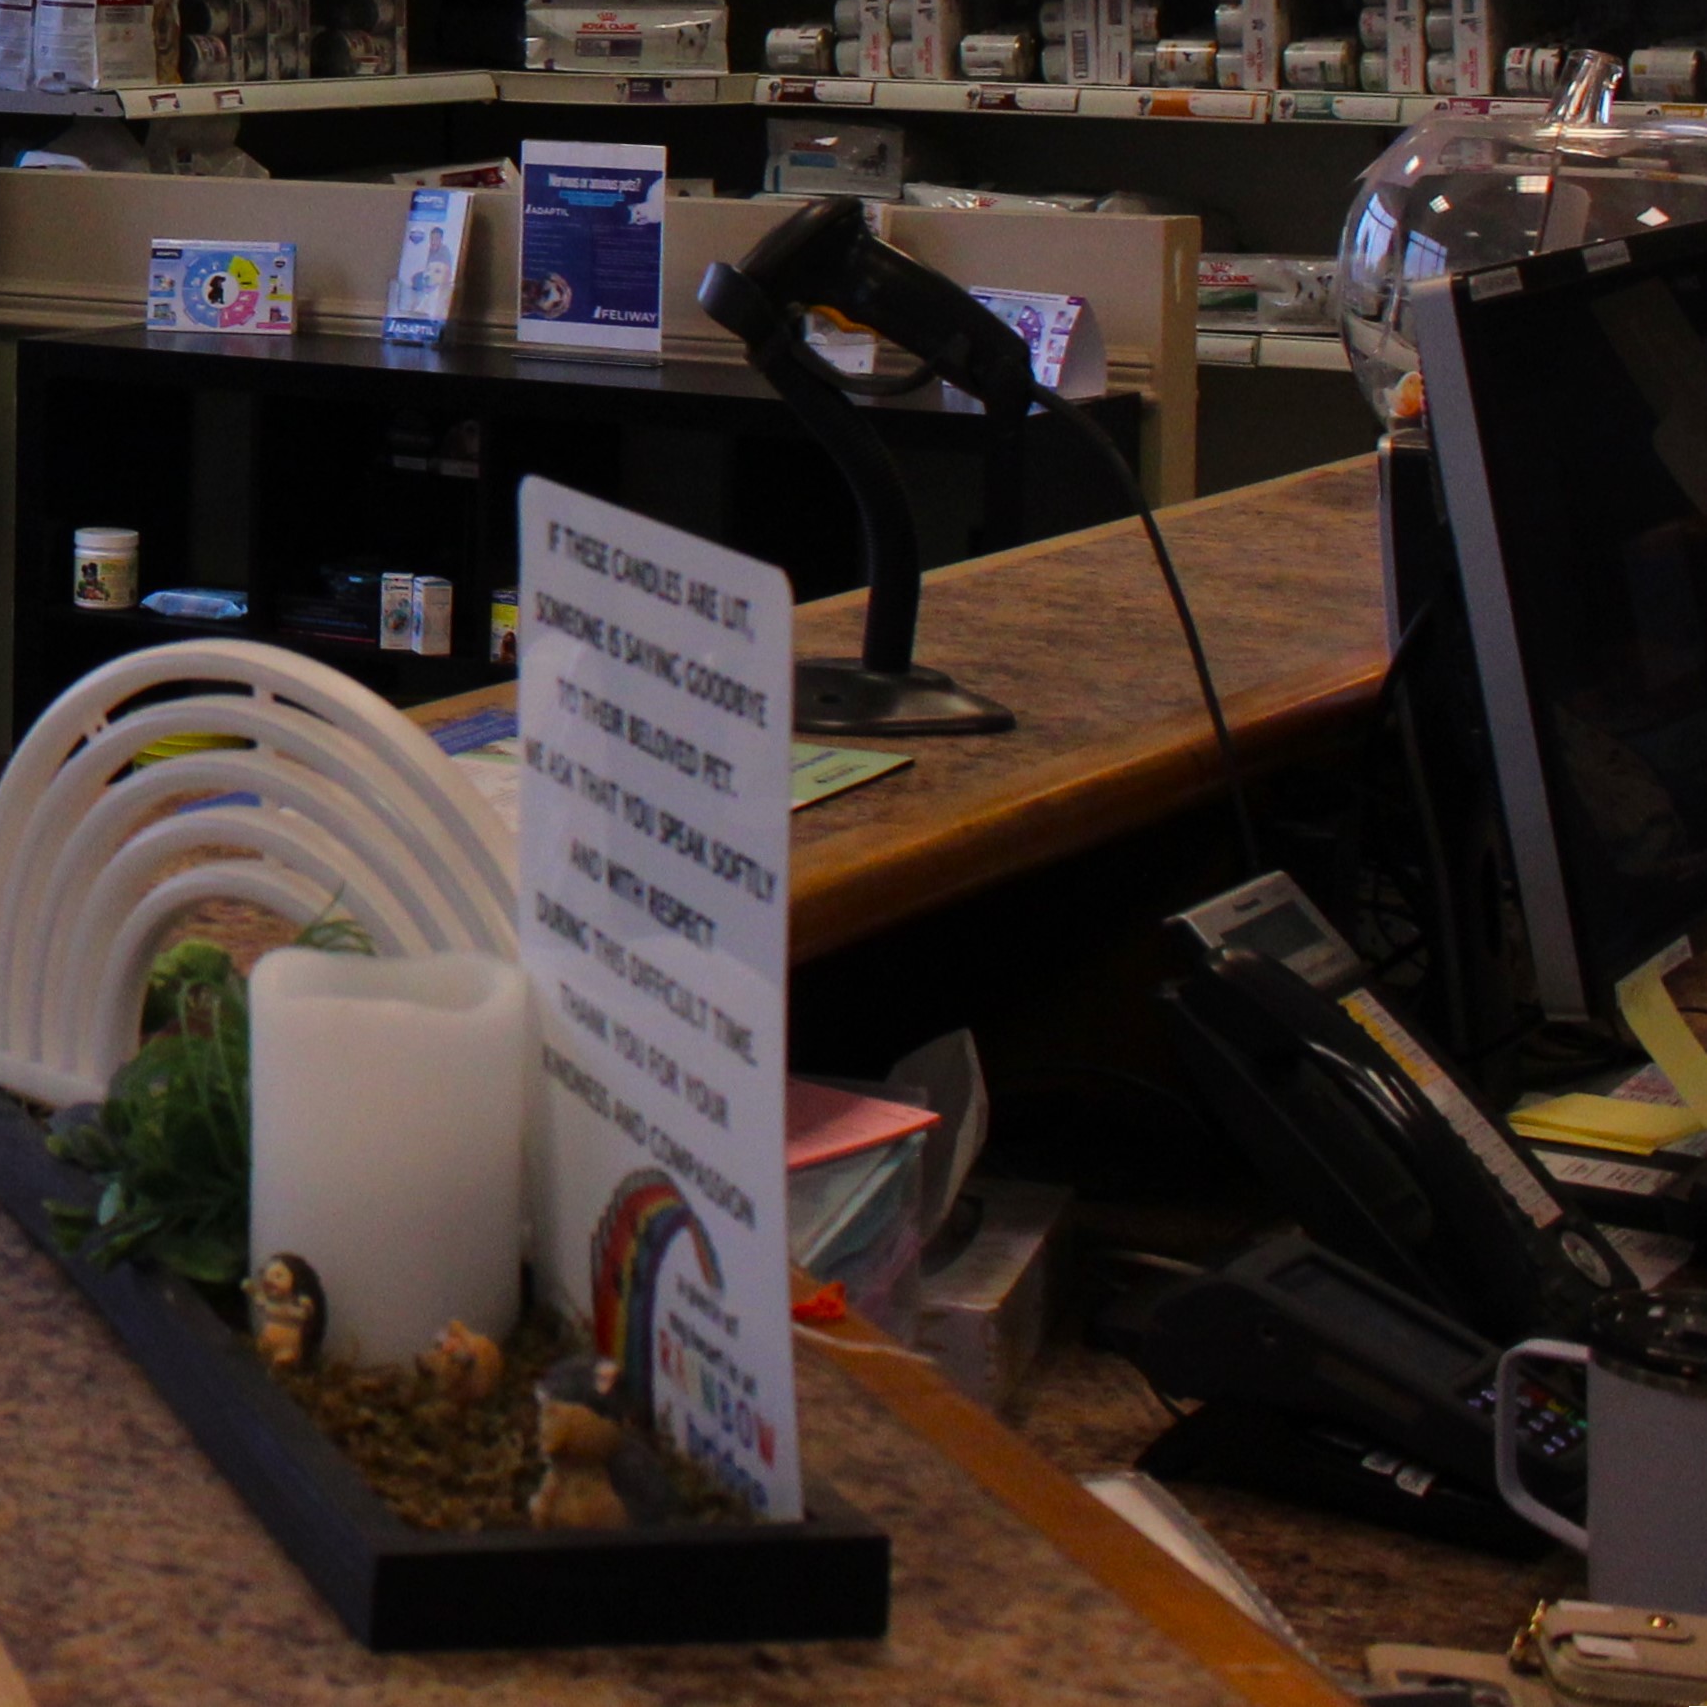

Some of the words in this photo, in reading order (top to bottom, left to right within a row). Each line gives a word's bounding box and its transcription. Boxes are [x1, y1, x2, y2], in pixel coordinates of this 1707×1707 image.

[582, 22, 605, 31] ROYAL
[531, 206, 569, 217] ADAPTIL
[394, 323, 435, 335] ADAPTIL
[601, 308, 658, 323] FELIWAY
[1198, 274, 1219, 283] OYAL
[546, 520, 559, 553] IF
[562, 526, 610, 575] THESE
[611, 547, 682, 606] CANDLES
[687, 581, 720, 623] ARE
[534, 589, 605, 650] SOMEONE
[607, 623, 622, 659] IS
[623, 630, 681, 686] SAYING
[686, 659, 769, 729] GOODBYE
[558, 675, 581, 715] TO
[581, 687, 625, 737] THEIR
[626, 708, 698, 777] BELOVED
[525, 736, 546, 774] WE
[546, 749, 576, 789] ASK
[579, 765, 620, 815] THAT
[621, 787, 655, 836] YOU
[657, 808, 709, 864] SPEAK
[710, 834, 776, 905] SOFTLY
[569, 837, 603, 883] AND
[606, 856, 644, 901] WITH
[647, 885, 716, 952] RESPECT
[535, 890, 590, 953] DURING
[592, 927, 627, 978] THIS
[628, 951, 709, 1032] DIFFICULT
[540, 1043, 611, 1120] KINDNESS
[612, 1097, 647, 1146] AND
[559, 980, 610, 1042] THANK
[610, 1019, 646, 1070] YOU
[647, 1044, 680, 1093] FOR
[683, 1073, 730, 1129] YOUR
[659, 1326, 776, 1472] RAINBOW
